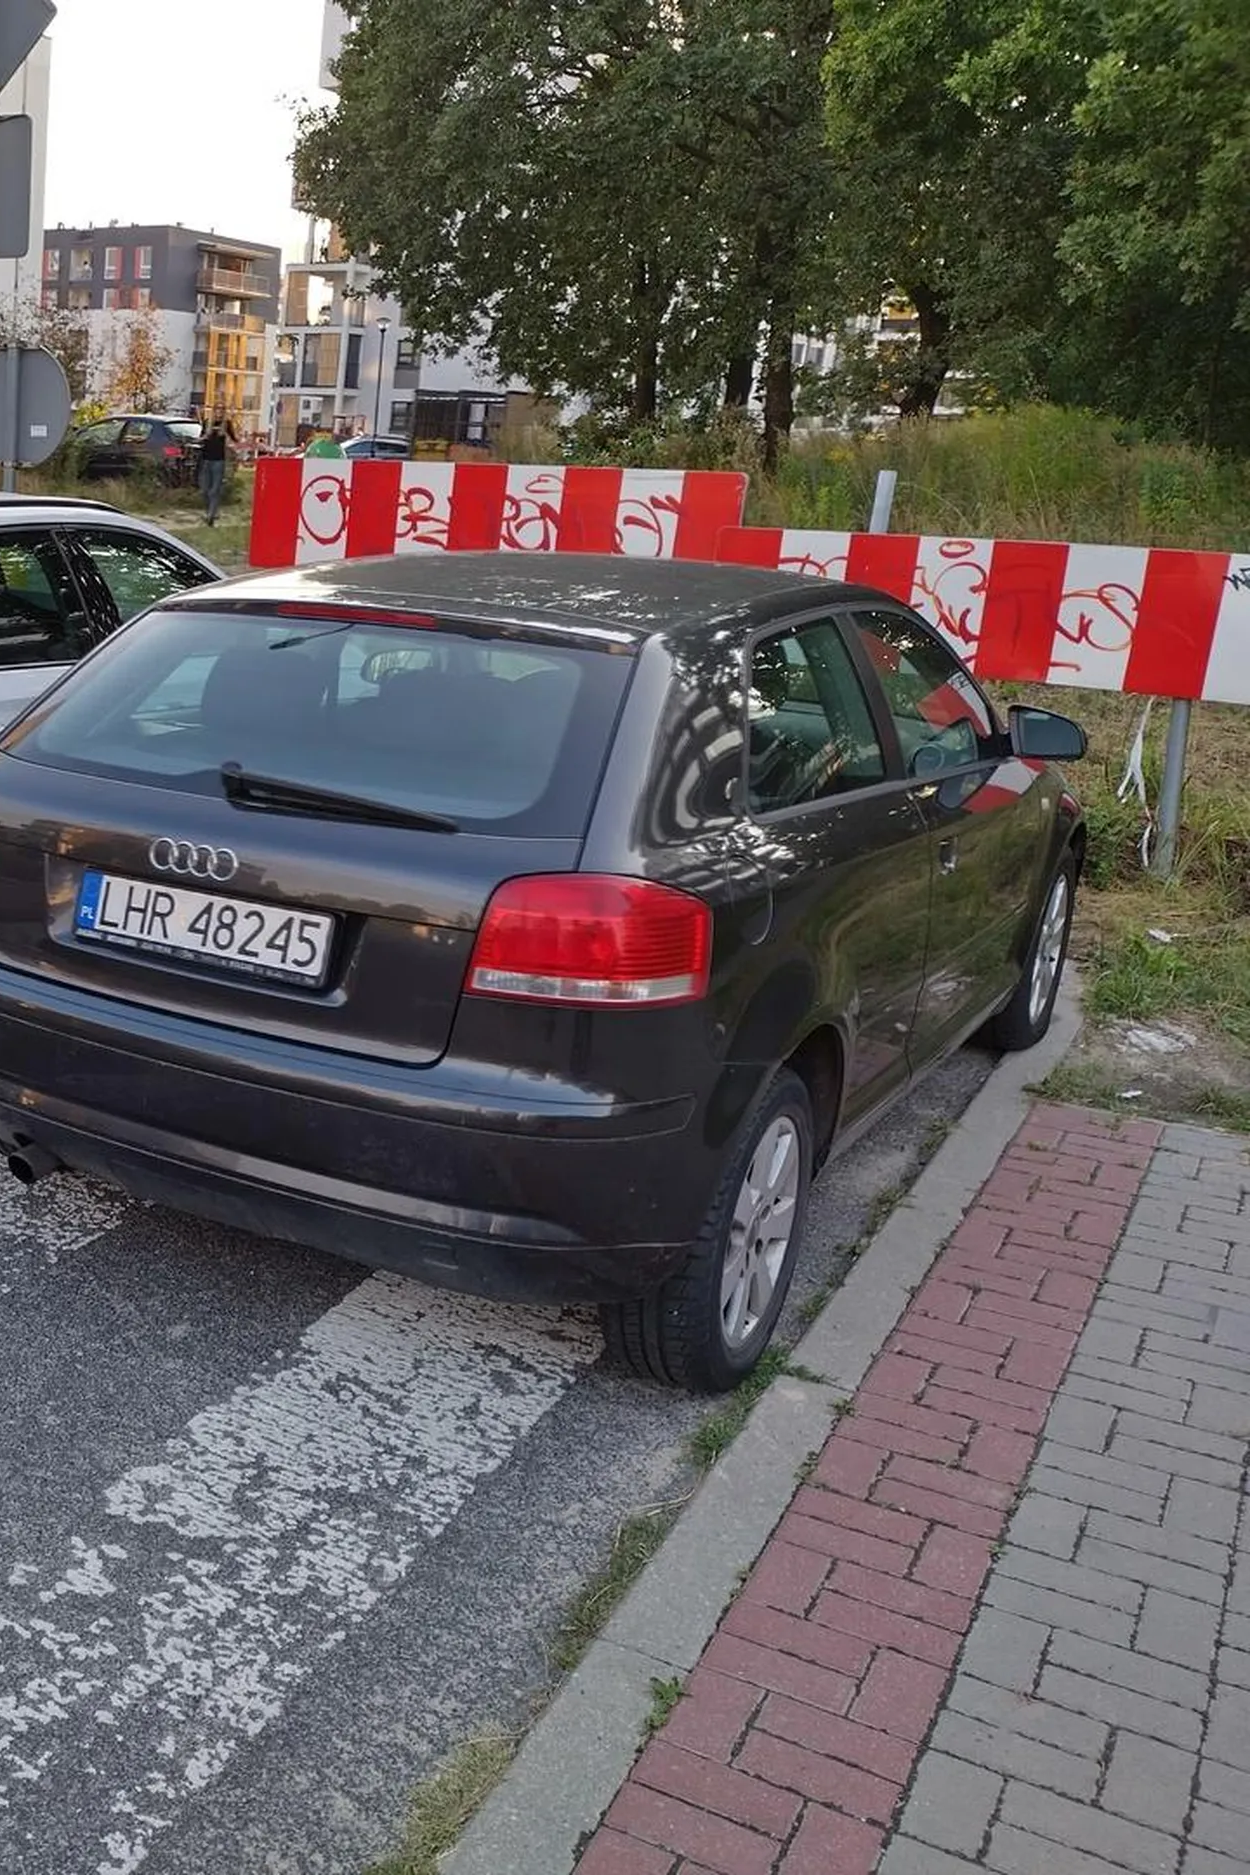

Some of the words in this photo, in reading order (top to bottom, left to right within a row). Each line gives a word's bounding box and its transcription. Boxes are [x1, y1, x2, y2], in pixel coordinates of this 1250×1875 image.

[80, 905, 95, 920] PL
[99, 881, 176, 940] LHR
[187, 902, 323, 968] 48245
